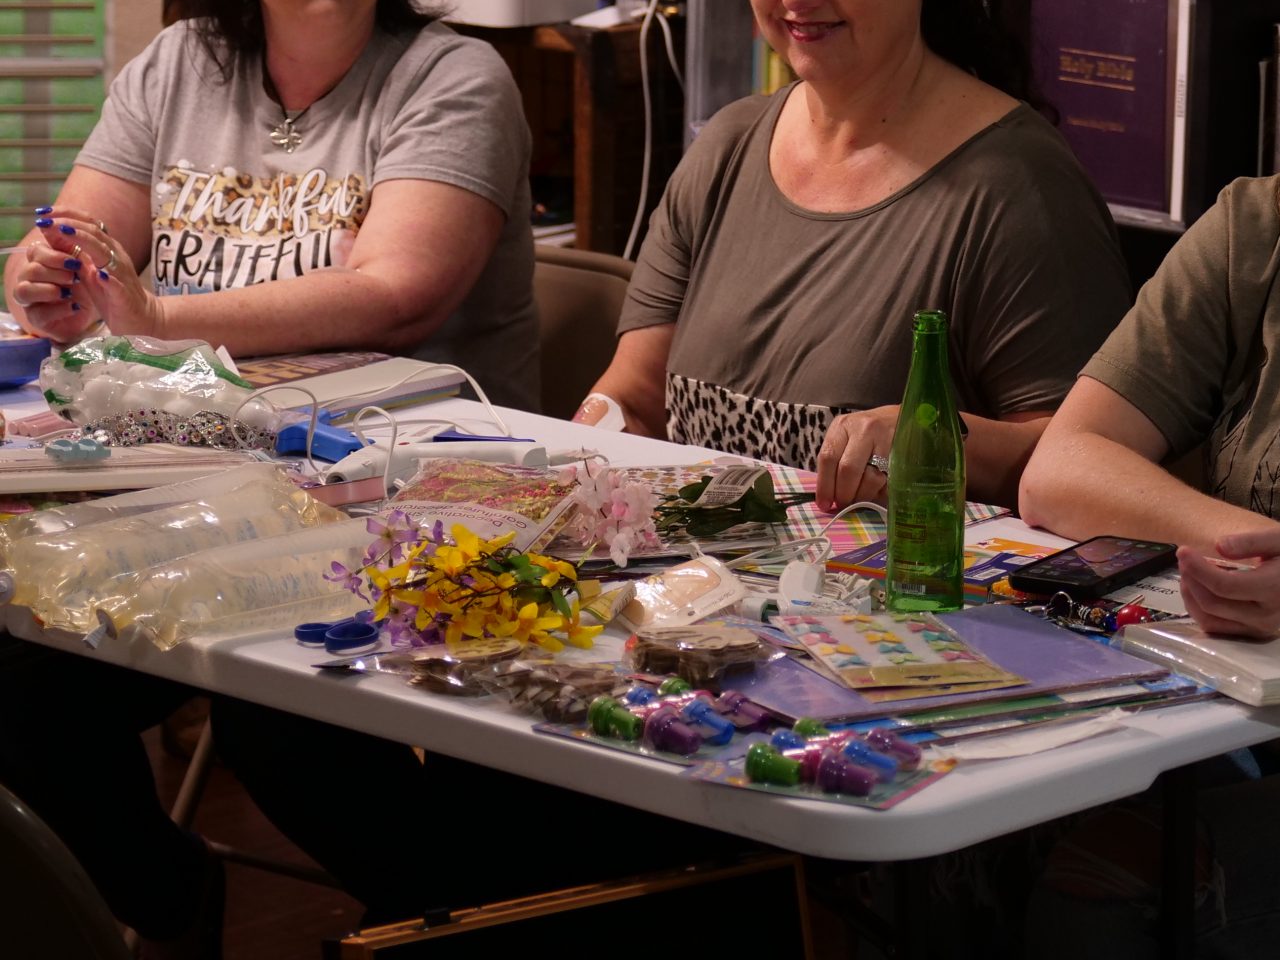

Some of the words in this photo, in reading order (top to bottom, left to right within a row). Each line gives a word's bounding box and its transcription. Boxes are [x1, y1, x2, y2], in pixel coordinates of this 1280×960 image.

[1058, 55, 1095, 81] Holy
[1096, 60, 1134, 82] Bible
[172, 167, 358, 239] Thankful
[427, 511, 504, 528] Decorative
